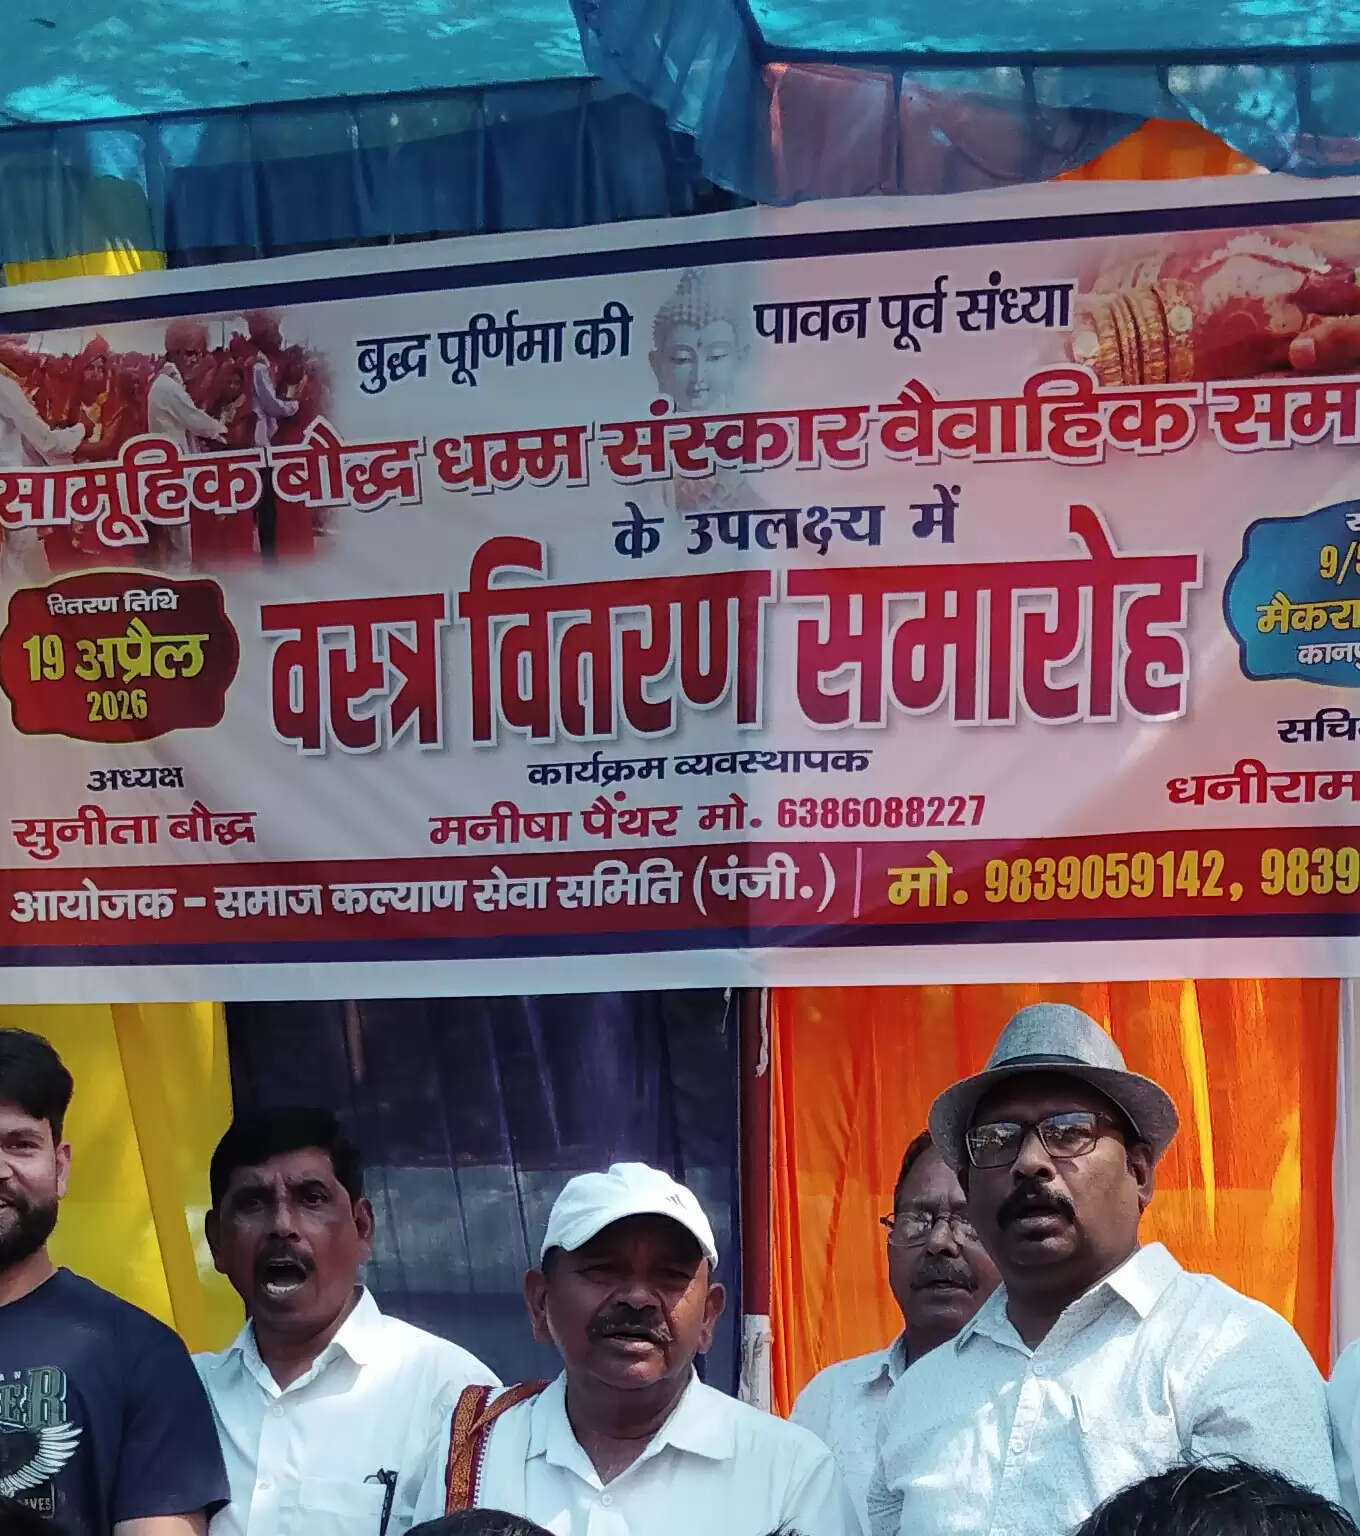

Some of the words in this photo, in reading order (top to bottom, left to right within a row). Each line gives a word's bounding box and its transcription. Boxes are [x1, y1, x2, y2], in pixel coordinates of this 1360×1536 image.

[358, 333, 427, 393] बुद्ध
[440, 310, 564, 386] पूर्णिमा
[574, 302, 633, 358] की
[755, 294, 871, 345] पावन
[880, 278, 950, 351] पूर्व
[957, 270, 1074, 333] संध्या
[269, 415, 420, 508] बौद्ध
[433, 424, 590, 492] धम्म
[598, 397, 872, 484] संस्कार
[878, 370, 1203, 465] वैवाहिक
[611, 501, 665, 560] के
[684, 505, 886, 557] उपलक्ष्य
[909, 483, 961, 544] में
[47, 593, 120, 616] वितरण
[123, 588, 180, 613] तिथि
[259, 595, 446, 757] वस्त्र
[458, 536, 774, 746] वितरण
[787, 503, 1204, 730] समारोह
[22, 634, 65, 682] 19
[75, 616, 210, 685] अप्रैल
[86, 688, 149, 722] 2026
[86, 766, 184, 792] अध्यक्ष
[527, 751, 666, 788] कार्यक्रम
[674, 750, 873, 776] व्यवस्थापक
[11, 804, 160, 861] सुनीता
[167, 800, 257, 845] बौद्ध
[429, 801, 572, 847] मनीषा
[580, 791, 683, 839] पैंथर
[697, 792, 762, 831] मो.
[777, 795, 986, 829] 6386088227
[10, 878, 175, 926] आयोजक
[214, 877, 322, 921] समाज
[330, 879, 467, 917] कल्याण
[474, 865, 549, 914] सेवा
[556, 858, 684, 910] समिति
[693, 851, 834, 917] (पंजी.)
[888, 850, 969, 907] मो.
[985, 850, 1244, 904] 9839059142,
